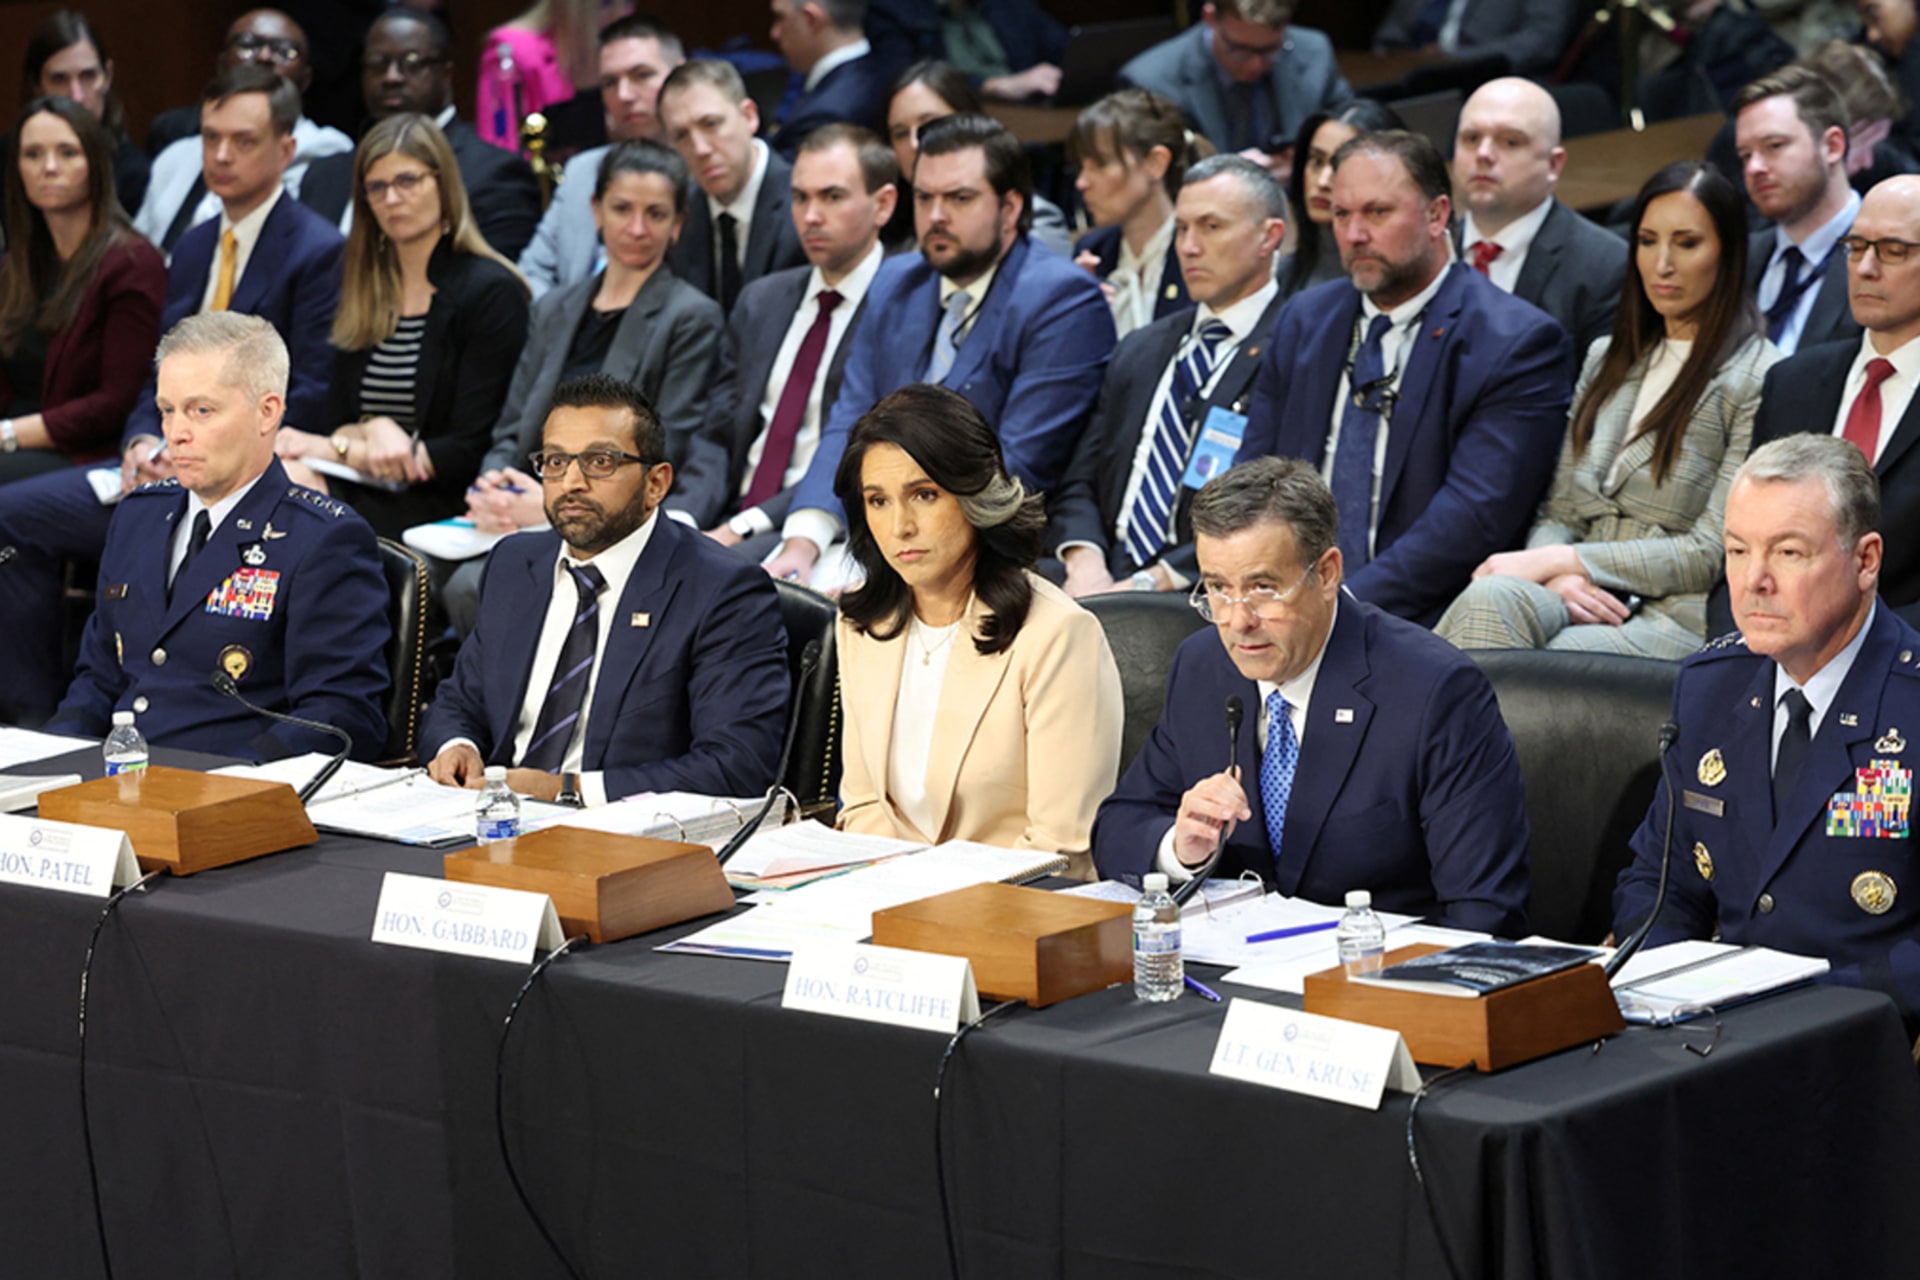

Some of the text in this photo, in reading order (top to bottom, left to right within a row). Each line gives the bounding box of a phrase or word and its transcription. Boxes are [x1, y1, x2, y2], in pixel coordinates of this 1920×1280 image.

[39, 858, 93, 886] PATEL
[381, 911, 528, 951] HON. GABBARD
[794, 976, 953, 1019] HON. RATCLIFFE
[1306, 1060, 1376, 1094] KRUSE
